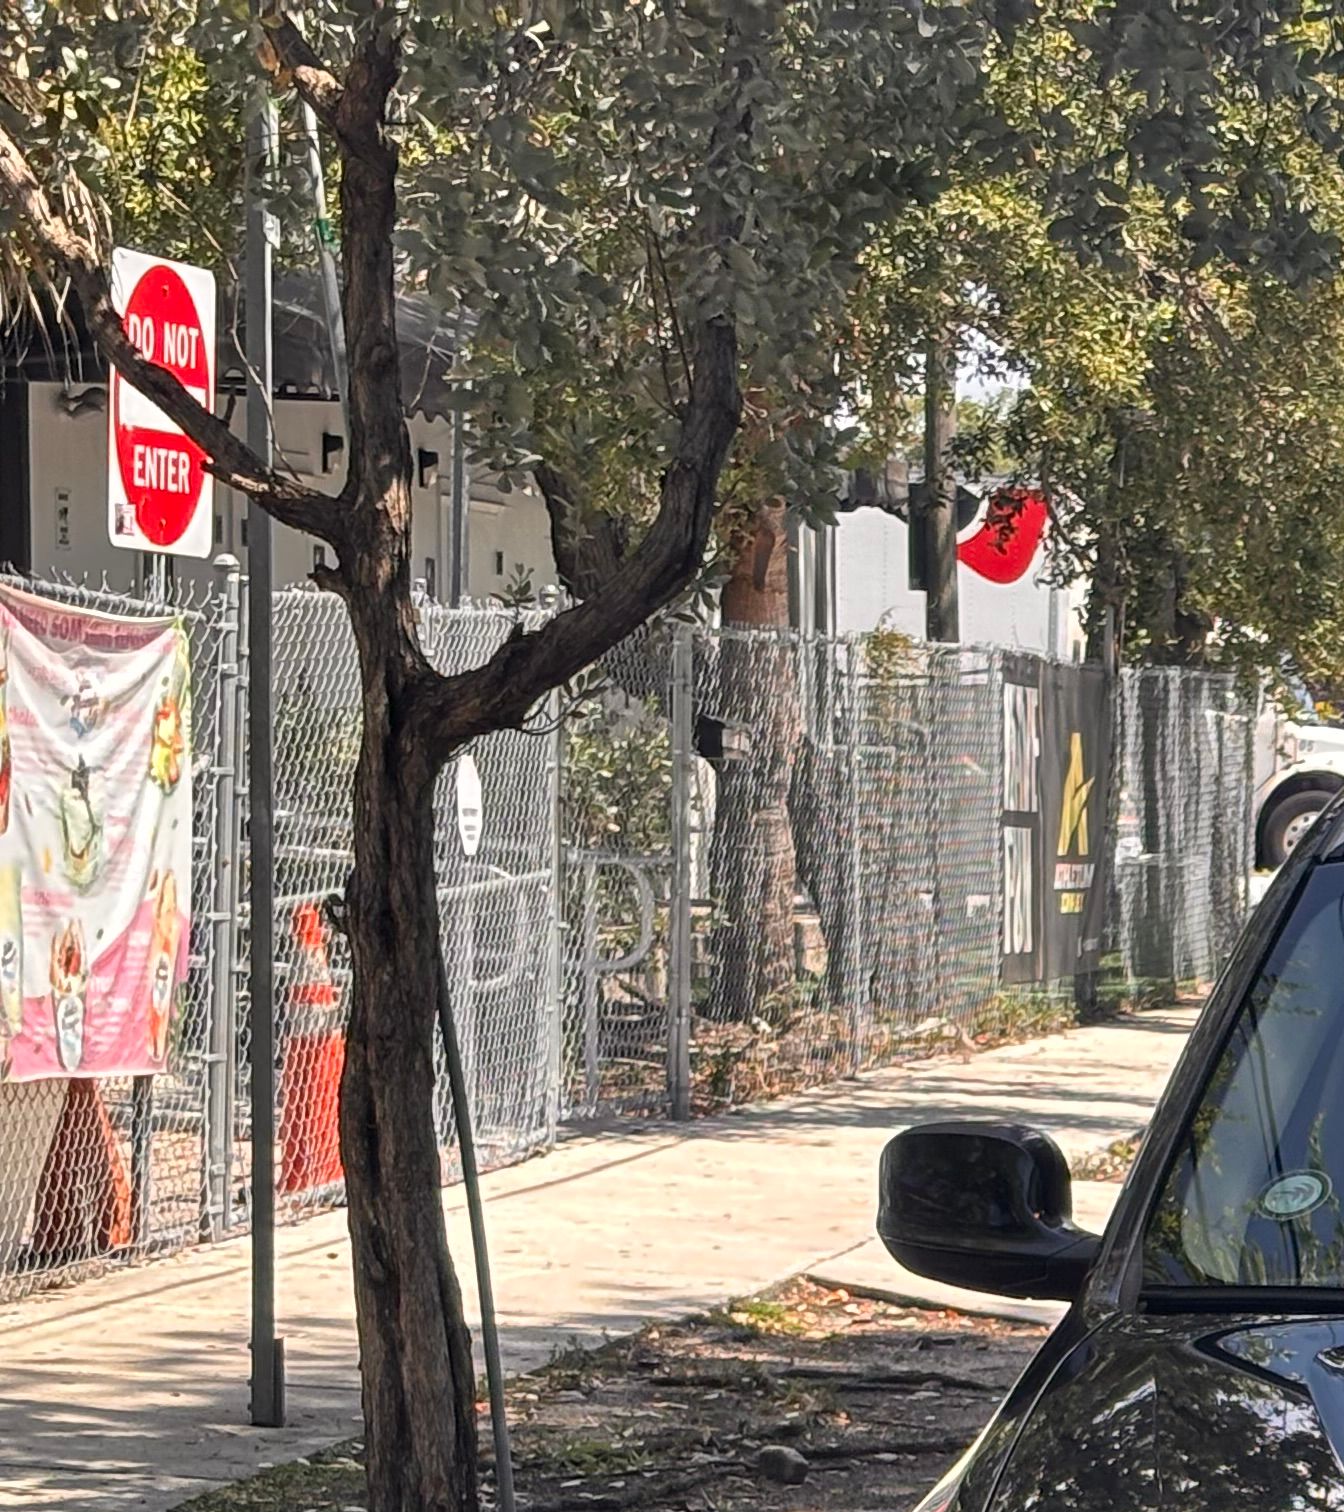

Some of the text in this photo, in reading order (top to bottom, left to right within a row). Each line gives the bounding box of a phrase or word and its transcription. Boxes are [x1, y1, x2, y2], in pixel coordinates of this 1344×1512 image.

[128, 313, 200, 370] DO NOT
[132, 444, 191, 494] ENTER
